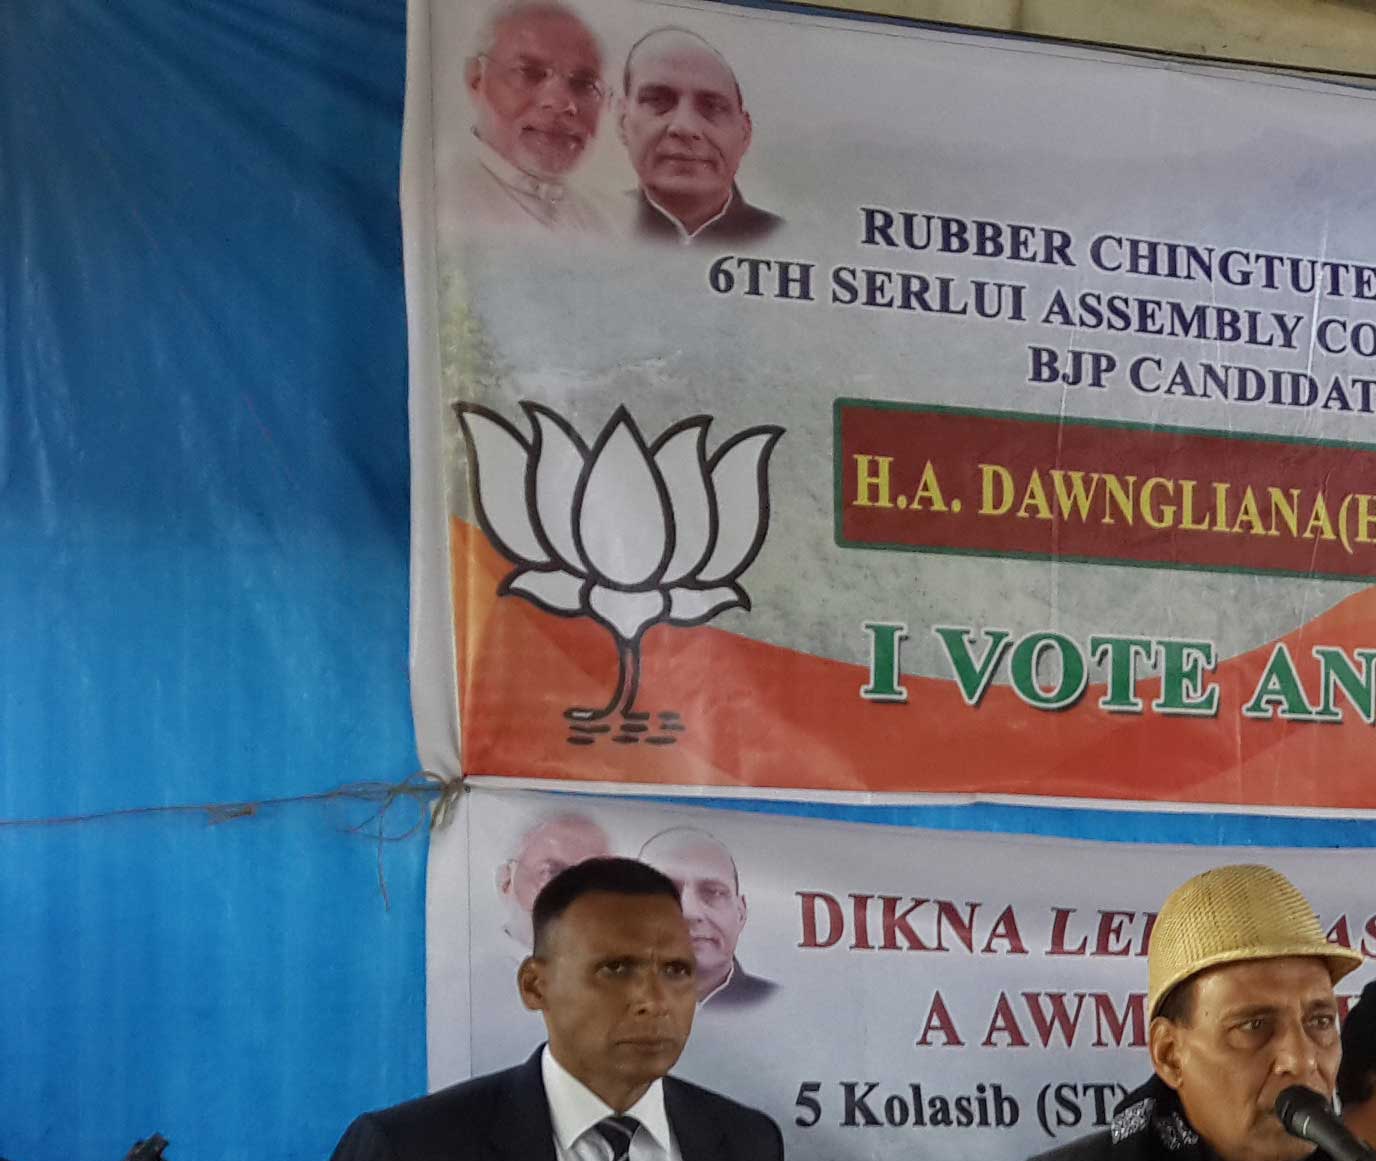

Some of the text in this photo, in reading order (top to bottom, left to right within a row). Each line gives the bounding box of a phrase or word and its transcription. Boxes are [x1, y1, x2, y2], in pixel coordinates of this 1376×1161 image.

[860, 207, 1077, 267] RUBBER
[708, 256, 815, 301] 6TH
[831, 266, 1026, 321] SERLUI
[1042, 289, 1304, 349] ASSEMBLY
[1028, 346, 1116, 388] BJP
[853, 454, 961, 513] H.A.
[860, 623, 907, 700] I
[934, 626, 1219, 714] VOTE
[796, 891, 1028, 954] DIKNA
[916, 990, 964, 1046] A
[795, 1082, 822, 1126] 5
[839, 1082, 1019, 1127] Kolasib
